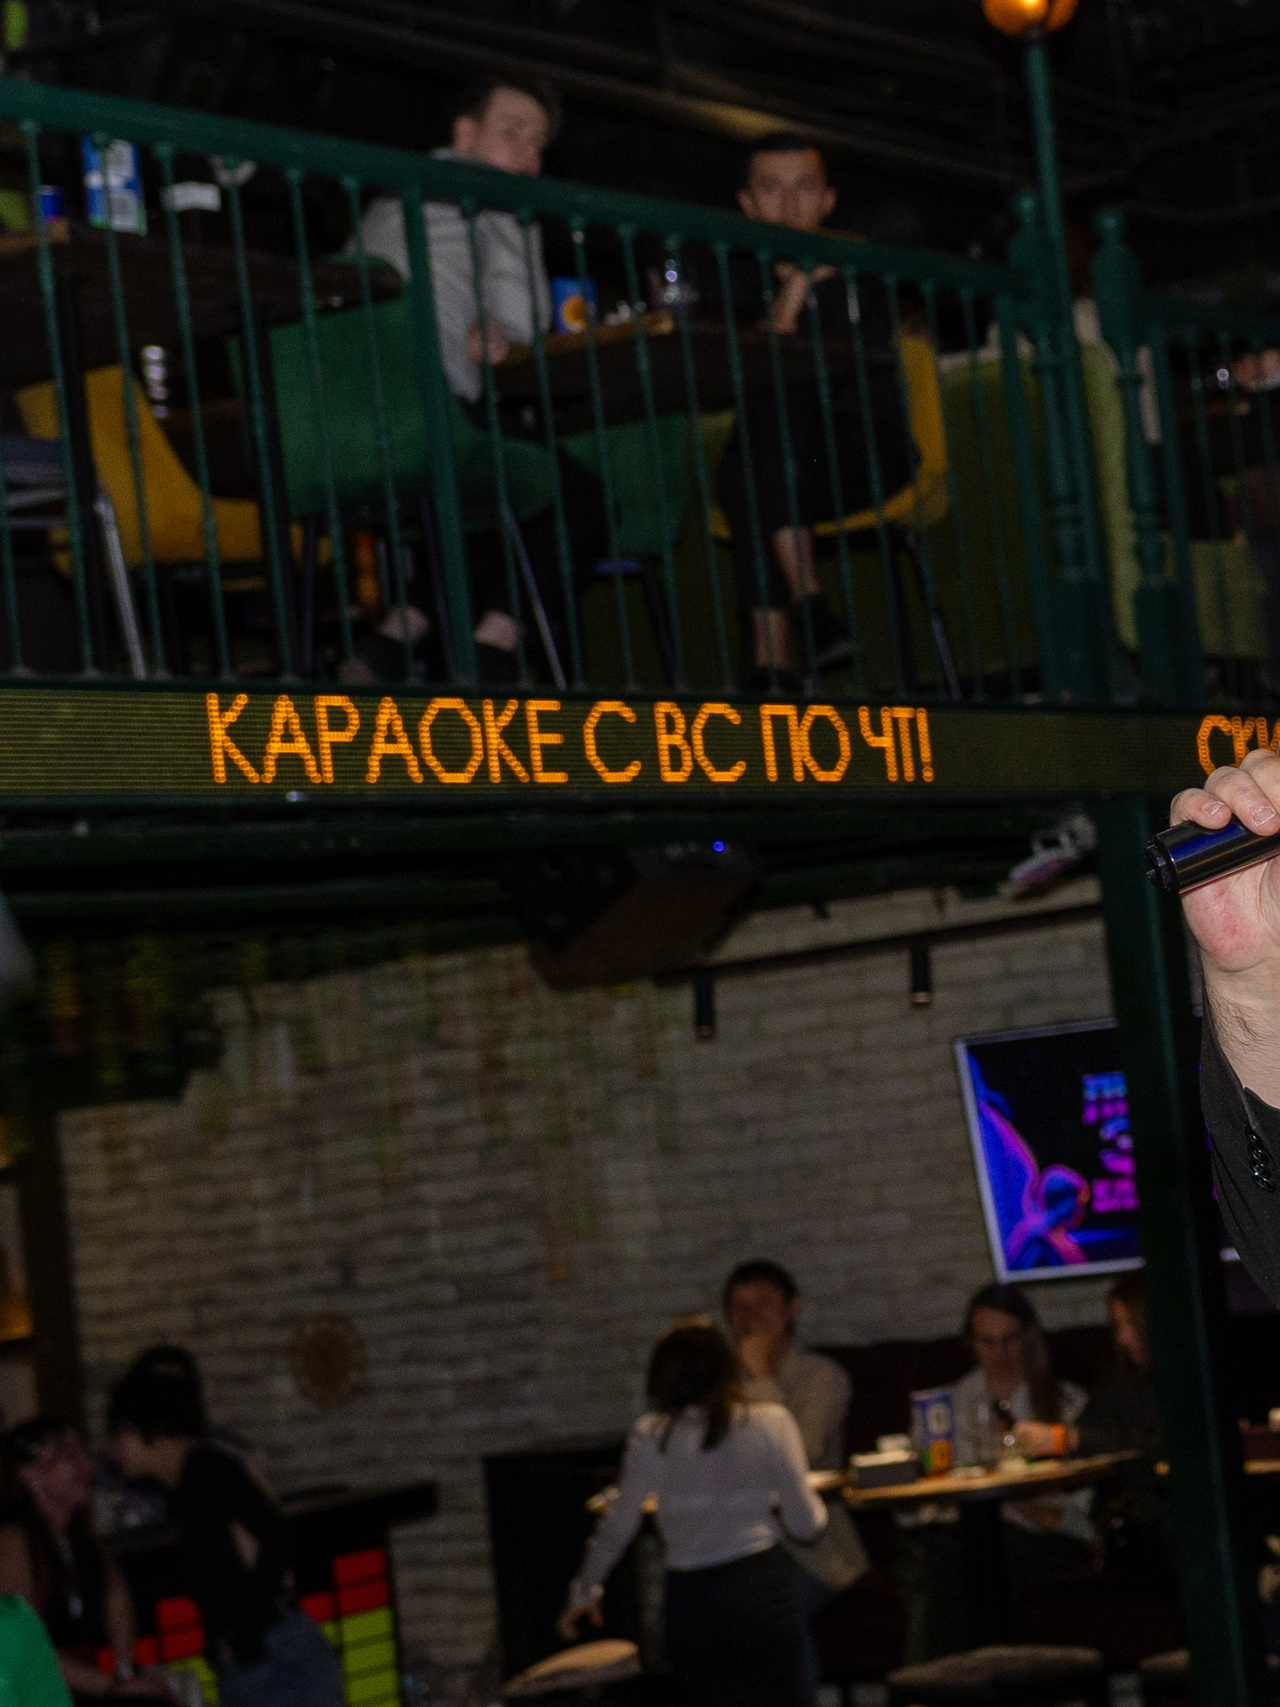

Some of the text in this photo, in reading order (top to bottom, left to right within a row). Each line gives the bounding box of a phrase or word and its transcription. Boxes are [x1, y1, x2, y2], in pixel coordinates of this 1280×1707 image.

[206, 692, 568, 783] КАРАОКЕ
[583, 700, 642, 783] С
[654, 701, 748, 783] ВС
[759, 704, 851, 782] ПО
